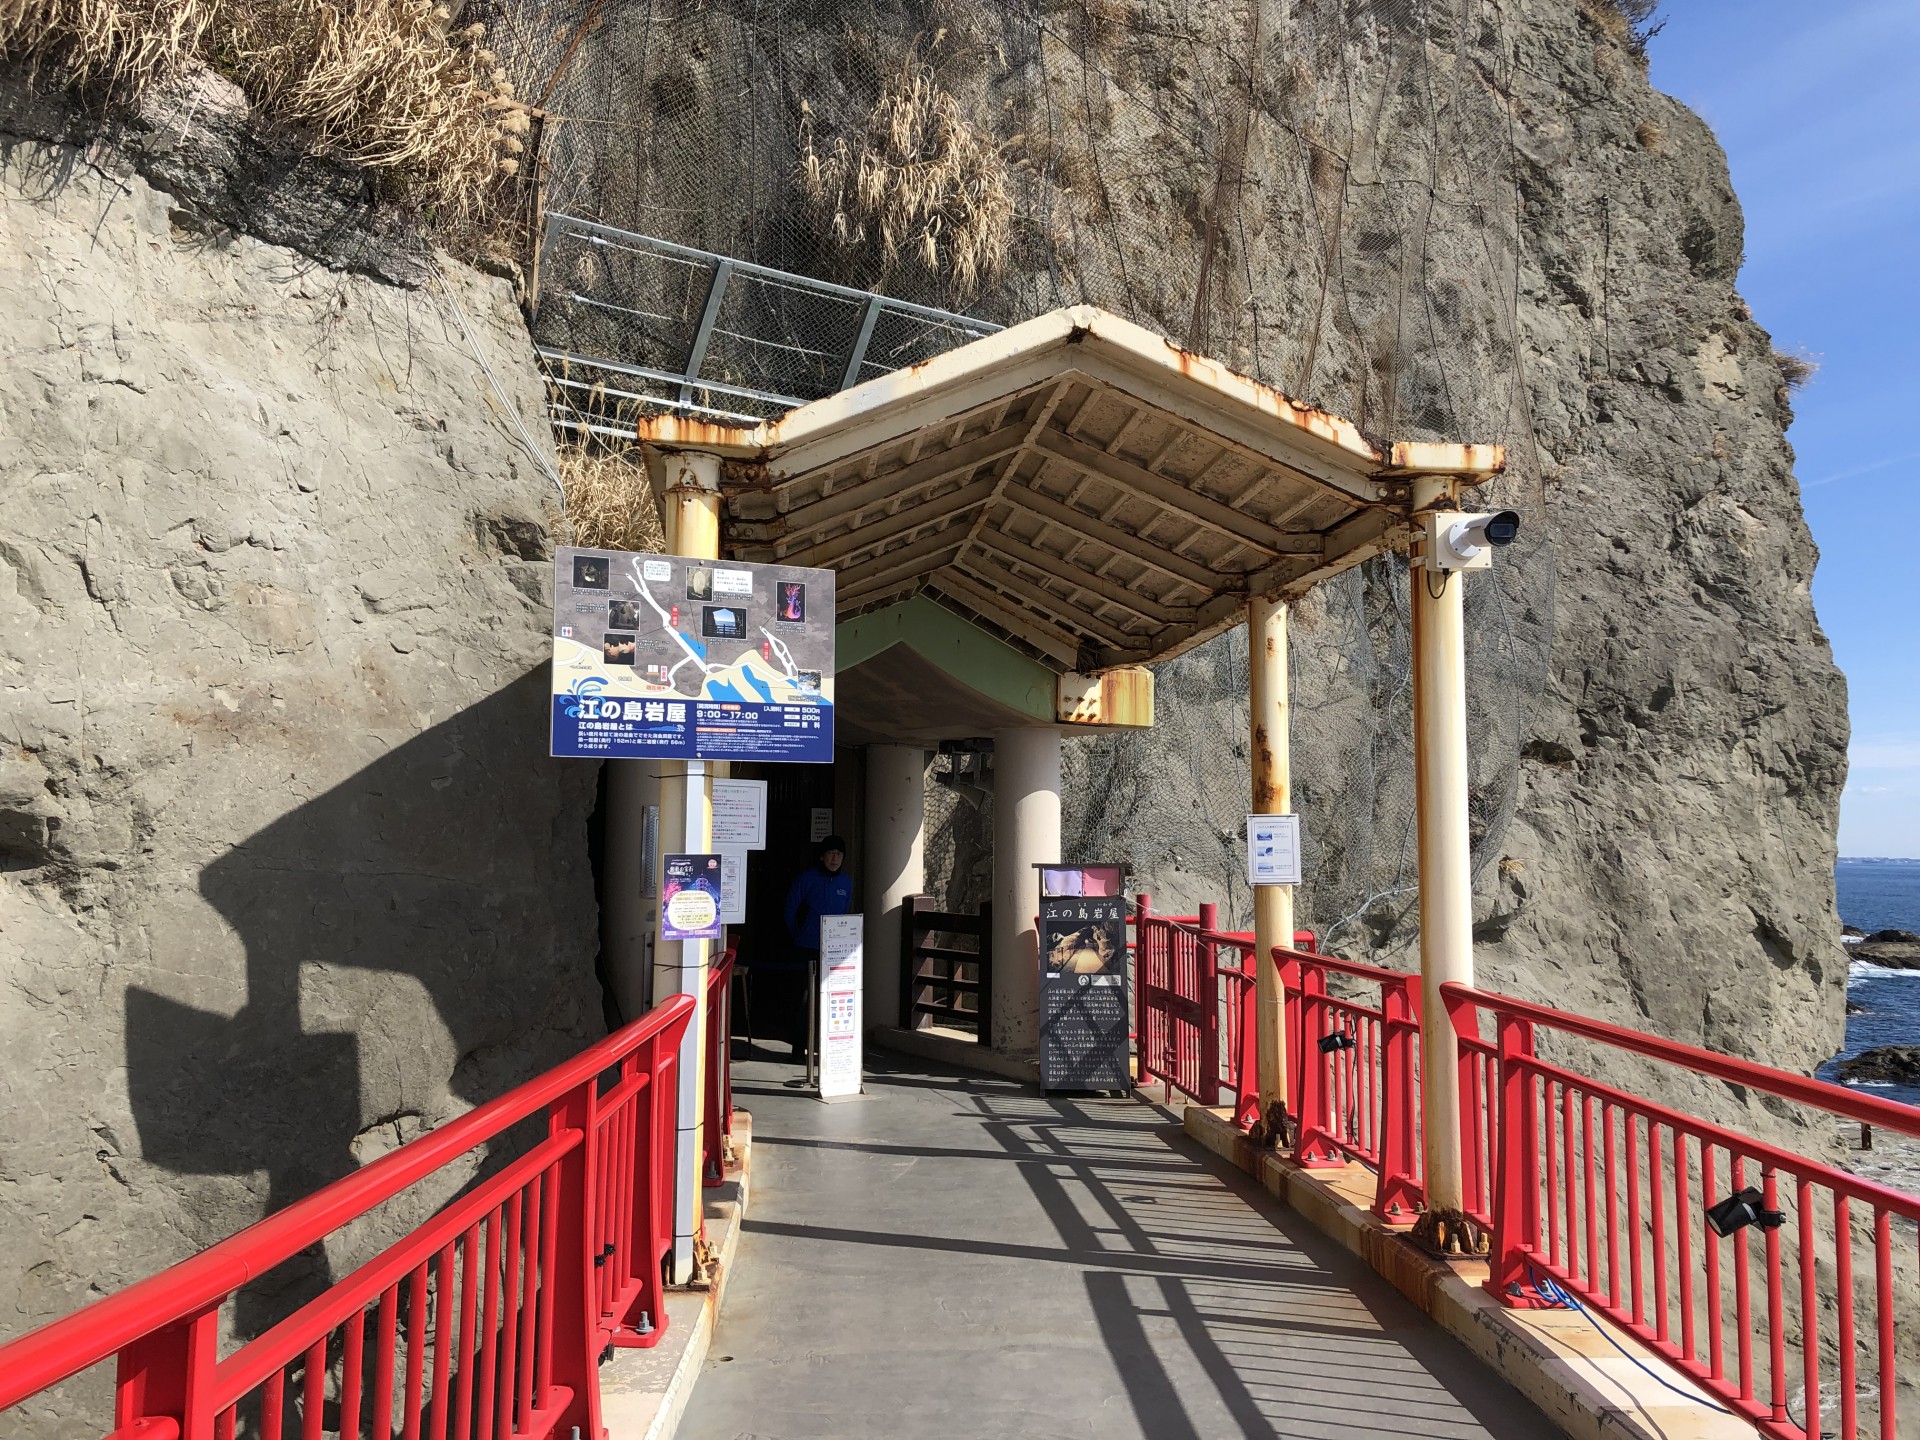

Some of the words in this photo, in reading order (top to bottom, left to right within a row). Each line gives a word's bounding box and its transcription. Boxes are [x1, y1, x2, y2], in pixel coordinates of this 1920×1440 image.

[578, 699, 686, 722] 江の島岩屋
[578, 722, 633, 731] 江の島岩屋とは
[1046, 907, 1119, 920] 江の島岩屋
